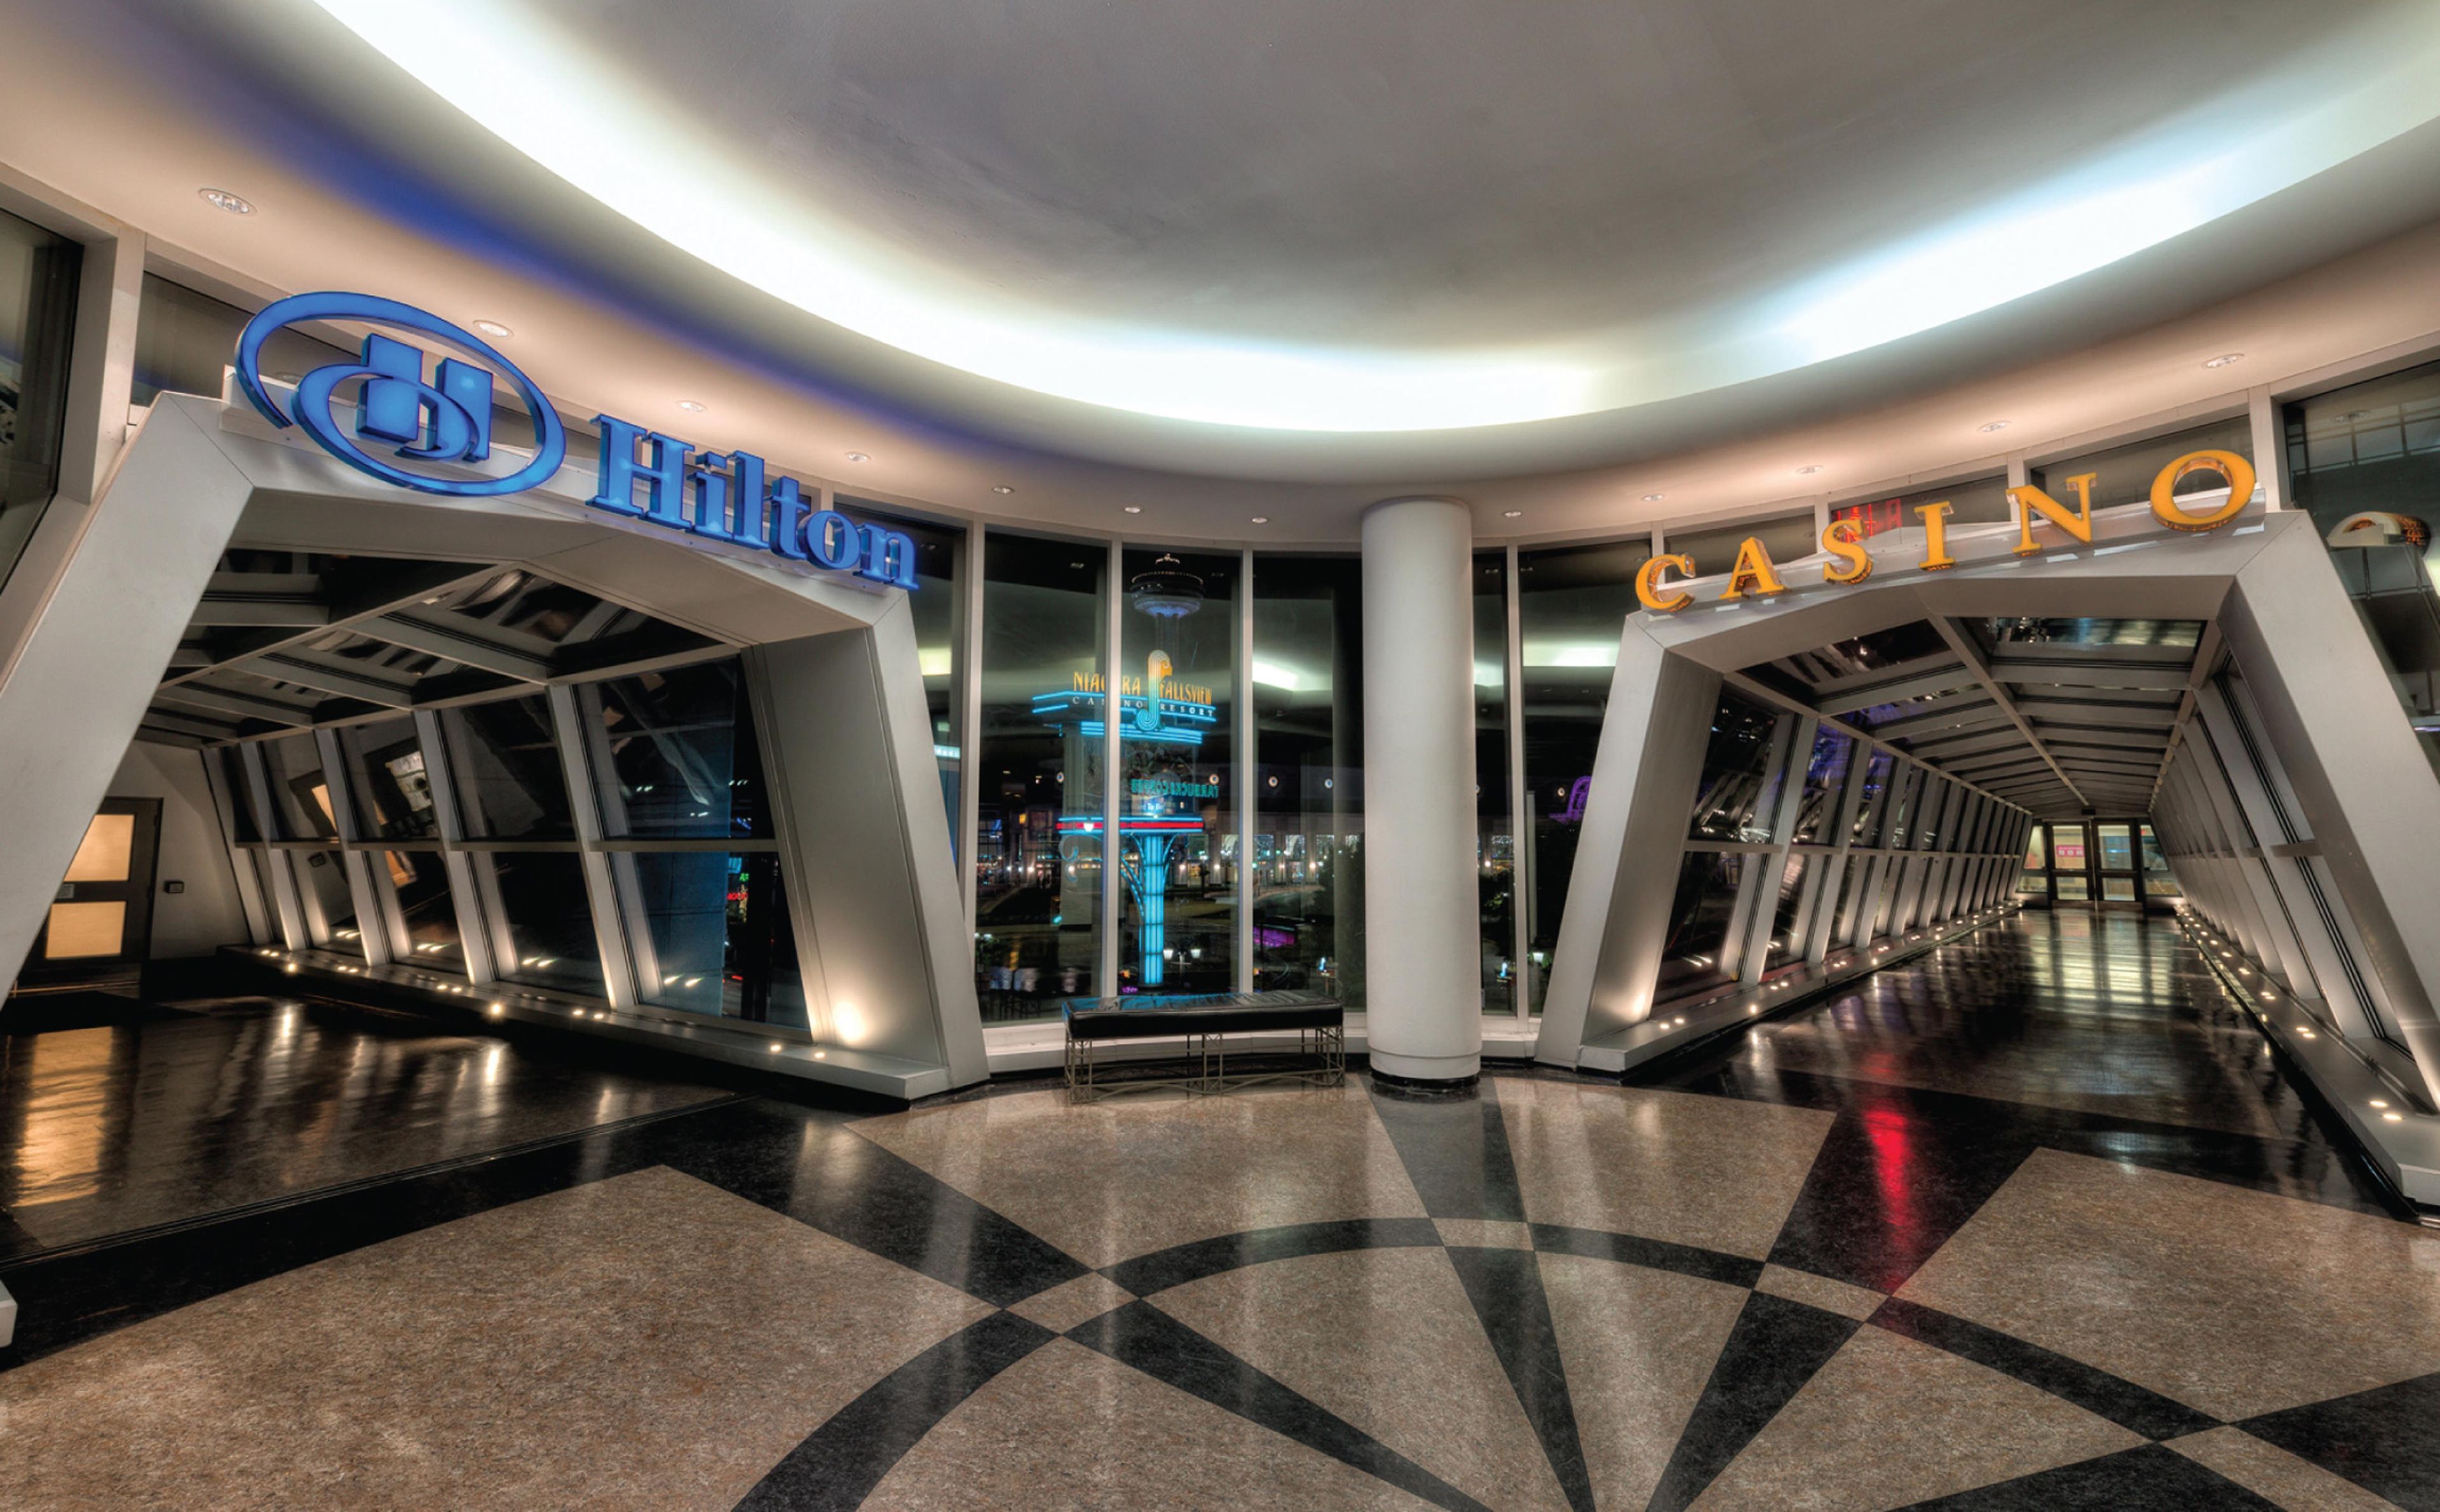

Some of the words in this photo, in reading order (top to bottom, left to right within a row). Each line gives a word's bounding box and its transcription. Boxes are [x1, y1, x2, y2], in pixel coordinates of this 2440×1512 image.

[585, 413, 920, 591] Hilton
[1635, 449, 2256, 612] CASINO
[1073, 671, 1141, 696] NIARA
[1160, 679, 1212, 705] FALLSVIEW
[1073, 696, 1142, 709] CANO
[1160, 703, 1213, 717] RESORT
